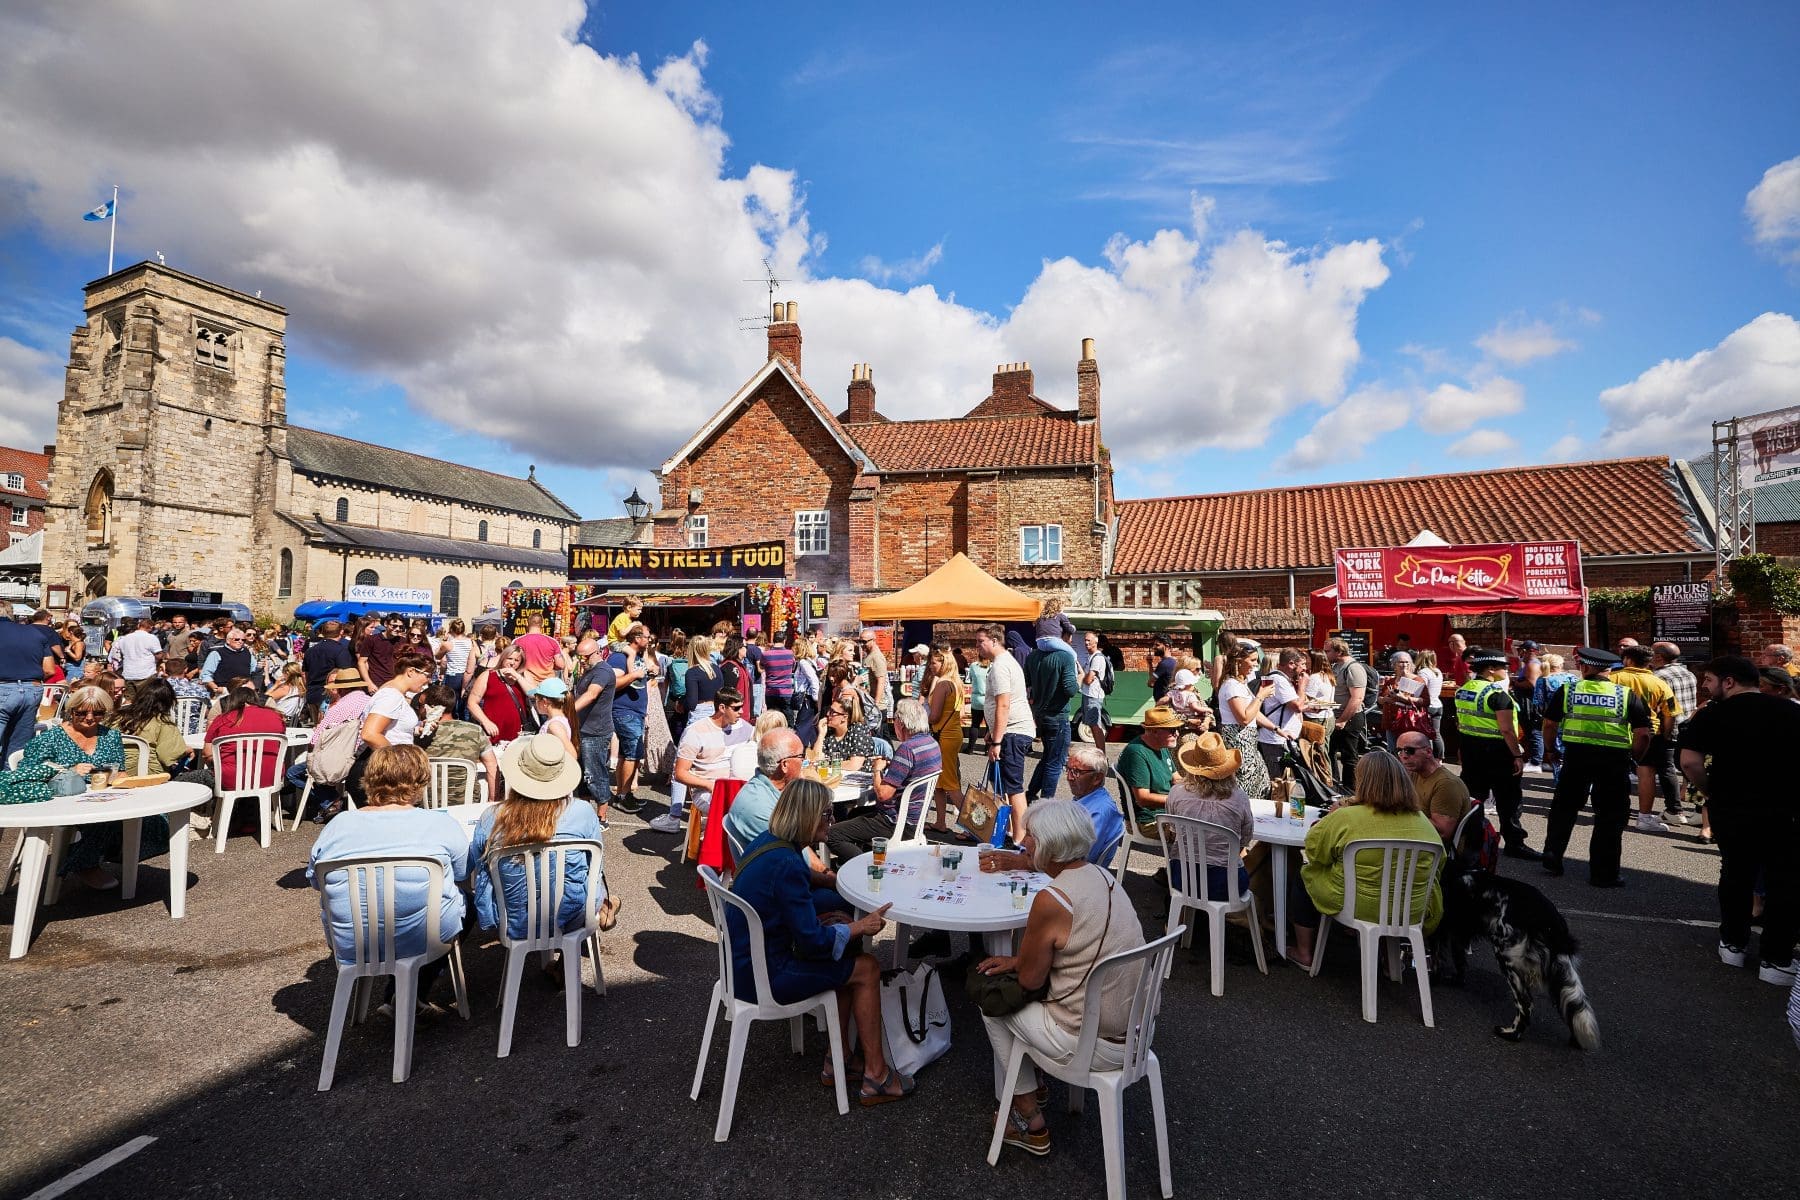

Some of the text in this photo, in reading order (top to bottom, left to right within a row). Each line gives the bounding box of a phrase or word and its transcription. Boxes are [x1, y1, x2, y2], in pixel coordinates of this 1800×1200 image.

[1766, 423, 1798, 441] VISIT
[1539, 545, 1564, 553] PULLED
[572, 546, 784, 569] INDIAN STREET FOOD
[1524, 553, 1565, 566] PORK
[1346, 558, 1382, 571] PORK
[1525, 568, 1567, 576] PORCHETTA
[1348, 582, 1383, 591] ITALIAN
[1526, 577, 1568, 588] ITALIAN
[351, 587, 430, 600] GREEK STREET FOOD
[1067, 578, 1204, 610] WAFFLES
[1348, 590, 1384, 598] SAUSAGE
[1527, 587, 1569, 596] SAUSAGE
[1654, 583, 1708, 595] 2 HOURS
[1674, 592, 1709, 600] PARKING
[516, 618, 549, 626] CATG
[514, 627, 551, 635] AVALE
[1575, 694, 1615, 707] POLICE
